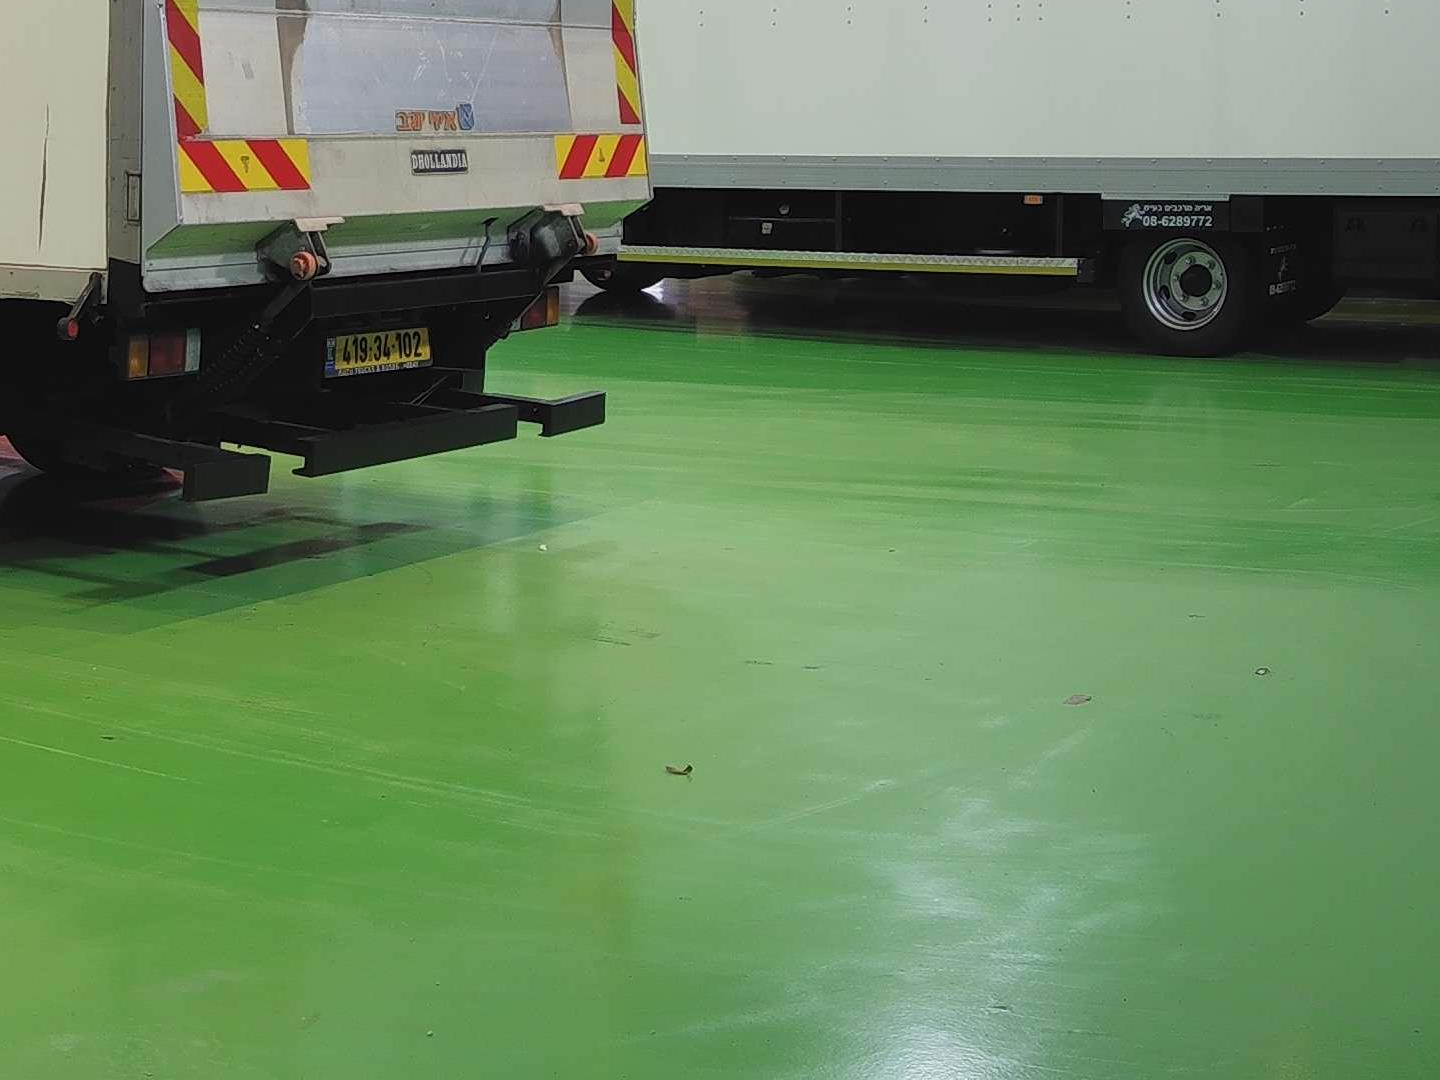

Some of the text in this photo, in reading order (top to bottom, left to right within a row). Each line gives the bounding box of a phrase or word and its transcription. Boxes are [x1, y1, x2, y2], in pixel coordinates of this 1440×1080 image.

[411, 152, 468, 169] DHOLLANDIA
[1142, 215, 1213, 227] 08-6289772
[342, 330, 423, 366] 419-34-102
